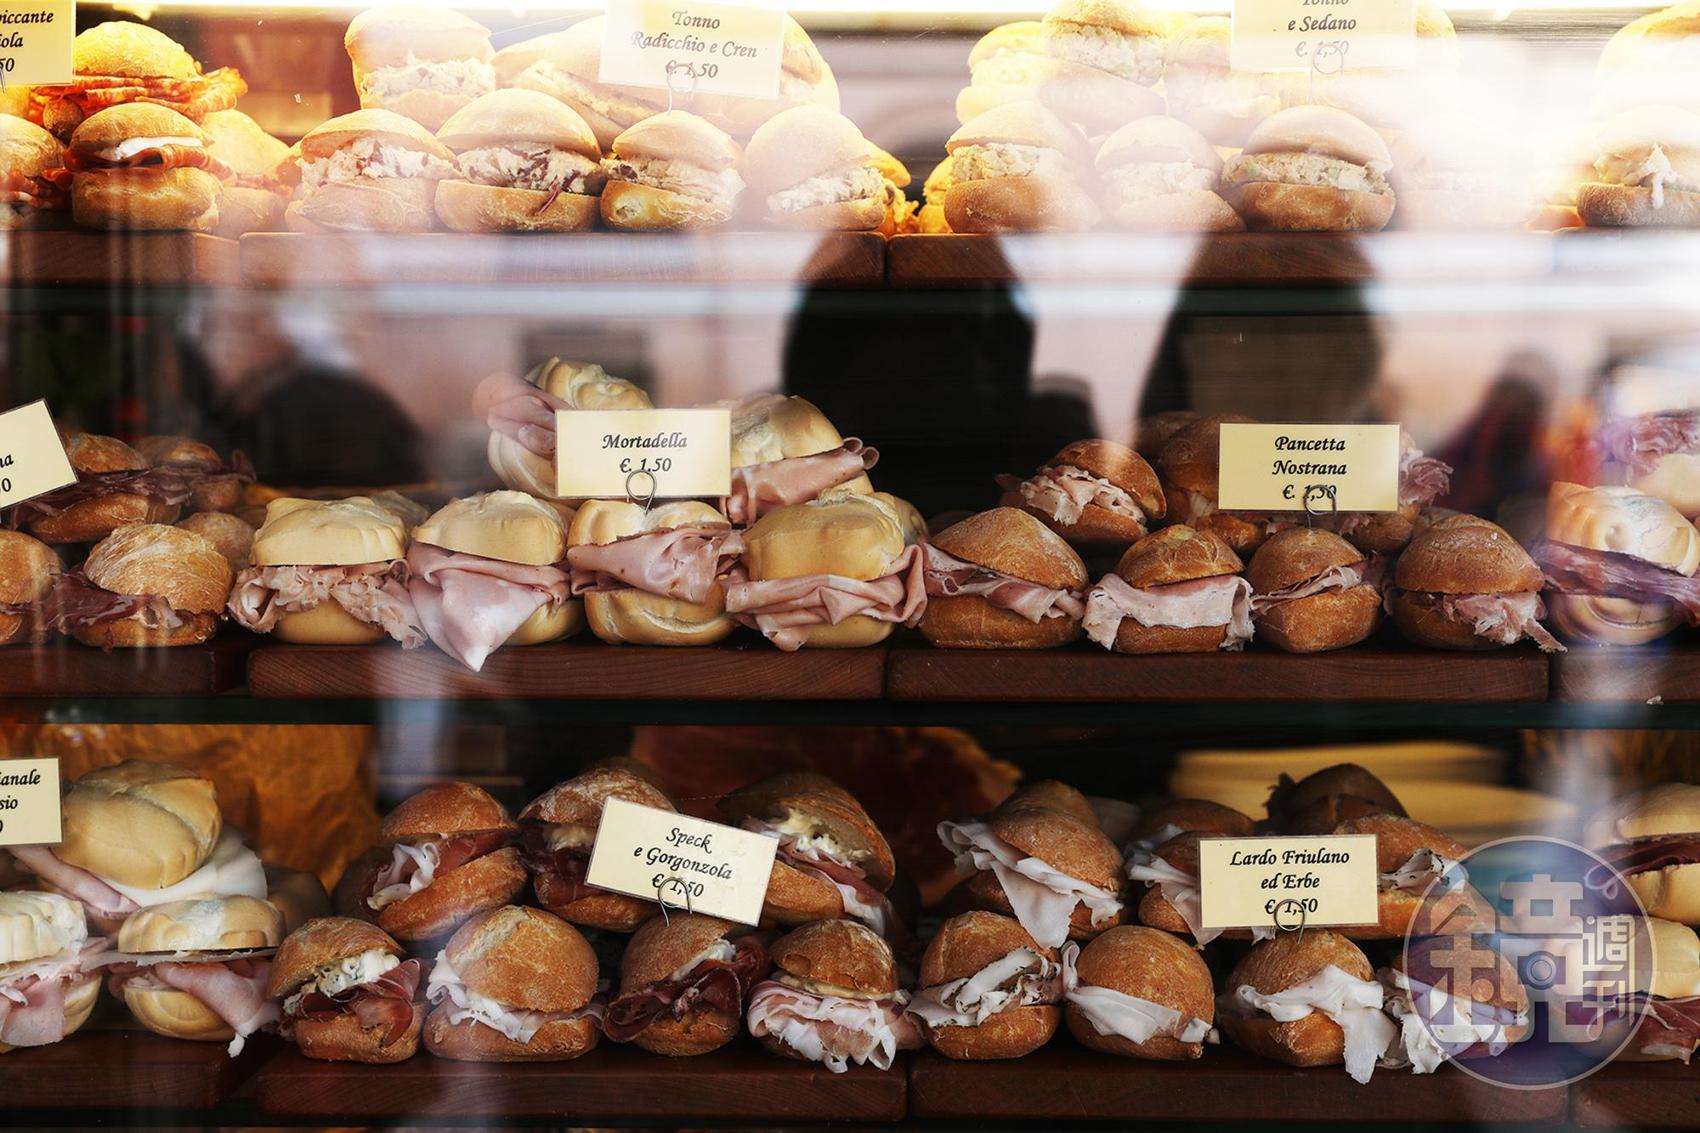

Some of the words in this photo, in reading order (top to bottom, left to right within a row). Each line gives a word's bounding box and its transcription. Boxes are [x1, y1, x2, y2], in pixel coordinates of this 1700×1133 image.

[671, 10, 721, 29] Tonno
[1287, 19, 1296, 31] e
[1299, 14, 1357, 32] Sedano
[630, 31, 705, 53] Radicchio
[709, 42, 718, 53] e
[722, 41, 758, 58] Cren
[602, 432, 688, 449] Mortadella
[1274, 435, 1346, 451] Pancetta
[1272, 460, 1348, 476] Nostrana
[666, 826, 713, 855] Speck
[633, 846, 644, 857] e
[646, 846, 733, 881] Gorgonzola
[1229, 848, 1277, 866] Lardo
[1282, 847, 1350, 865] Friulano
[1260, 872, 1282, 890] ed
[1282, 871, 1320, 890] Erbe
